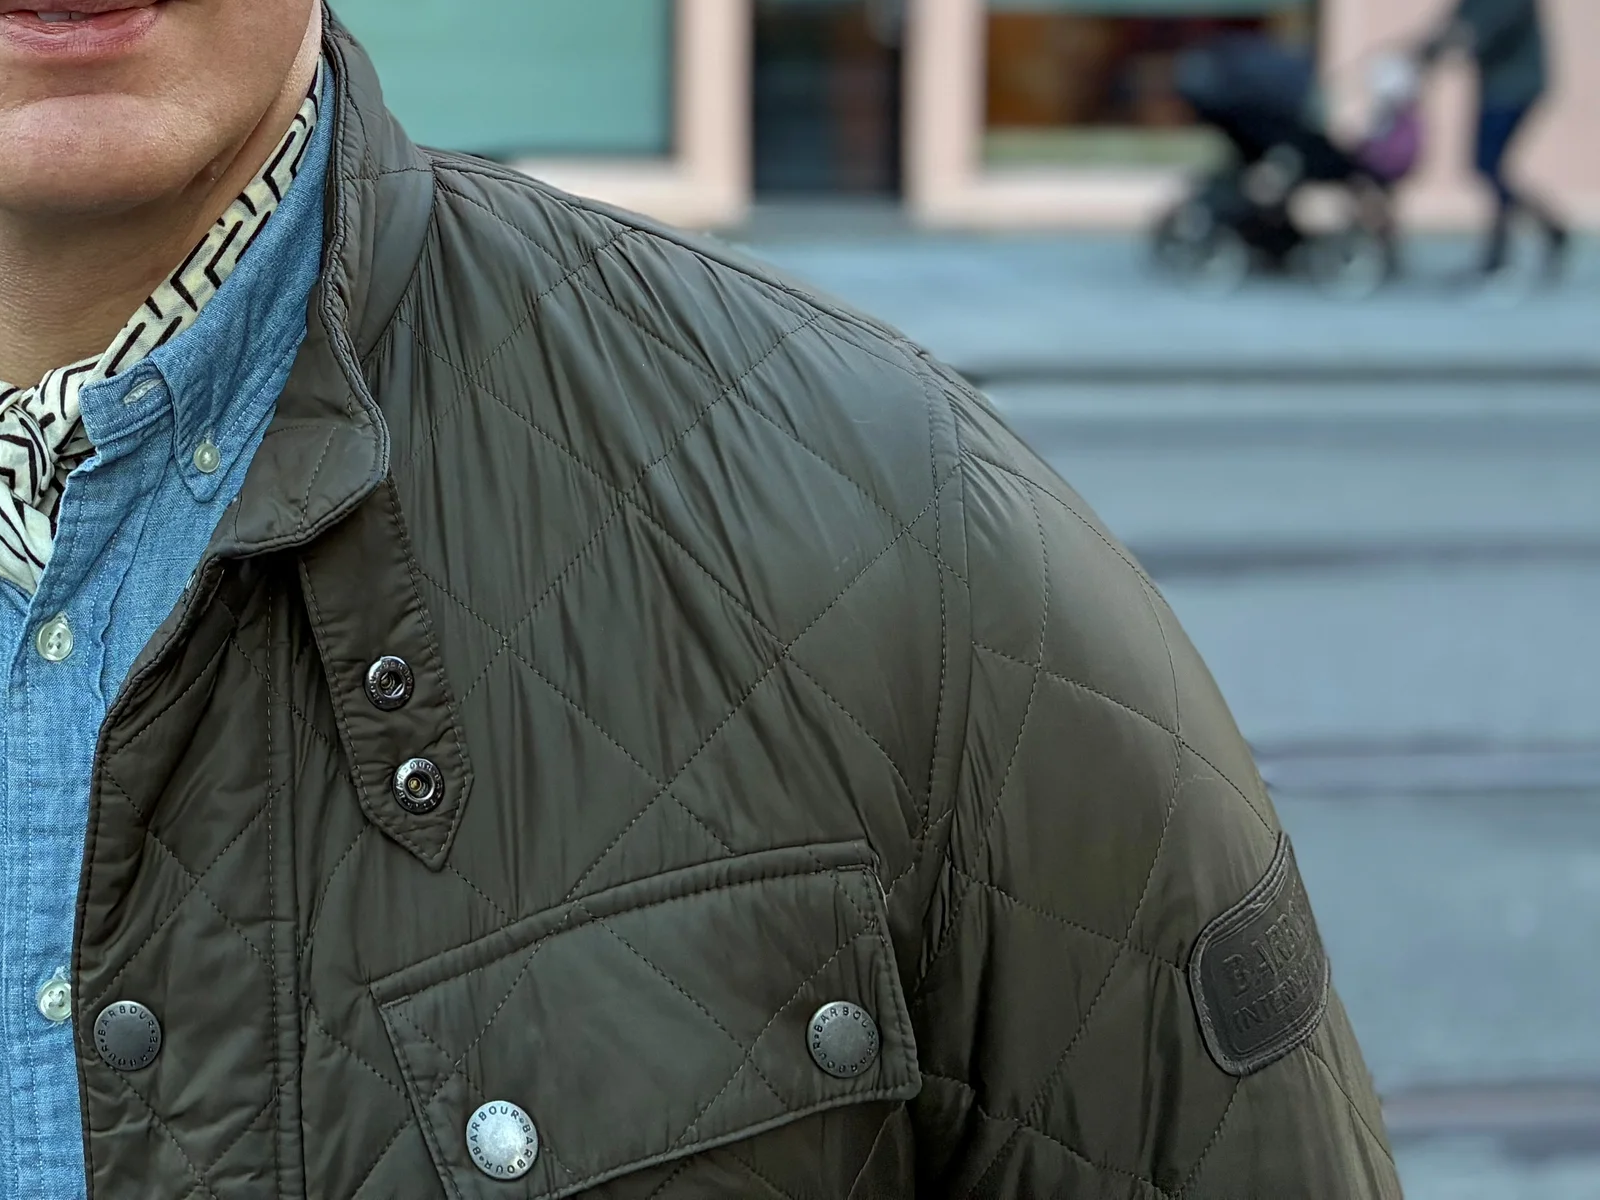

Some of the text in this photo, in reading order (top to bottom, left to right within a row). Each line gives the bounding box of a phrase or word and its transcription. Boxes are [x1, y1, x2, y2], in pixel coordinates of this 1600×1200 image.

[98, 1005, 155, 1036] BARBOUR
[814, 1006, 875, 1039] BARBOUR
[470, 1106, 520, 1156] BARBOUR
[484, 1124, 534, 1174] BARBOUR
